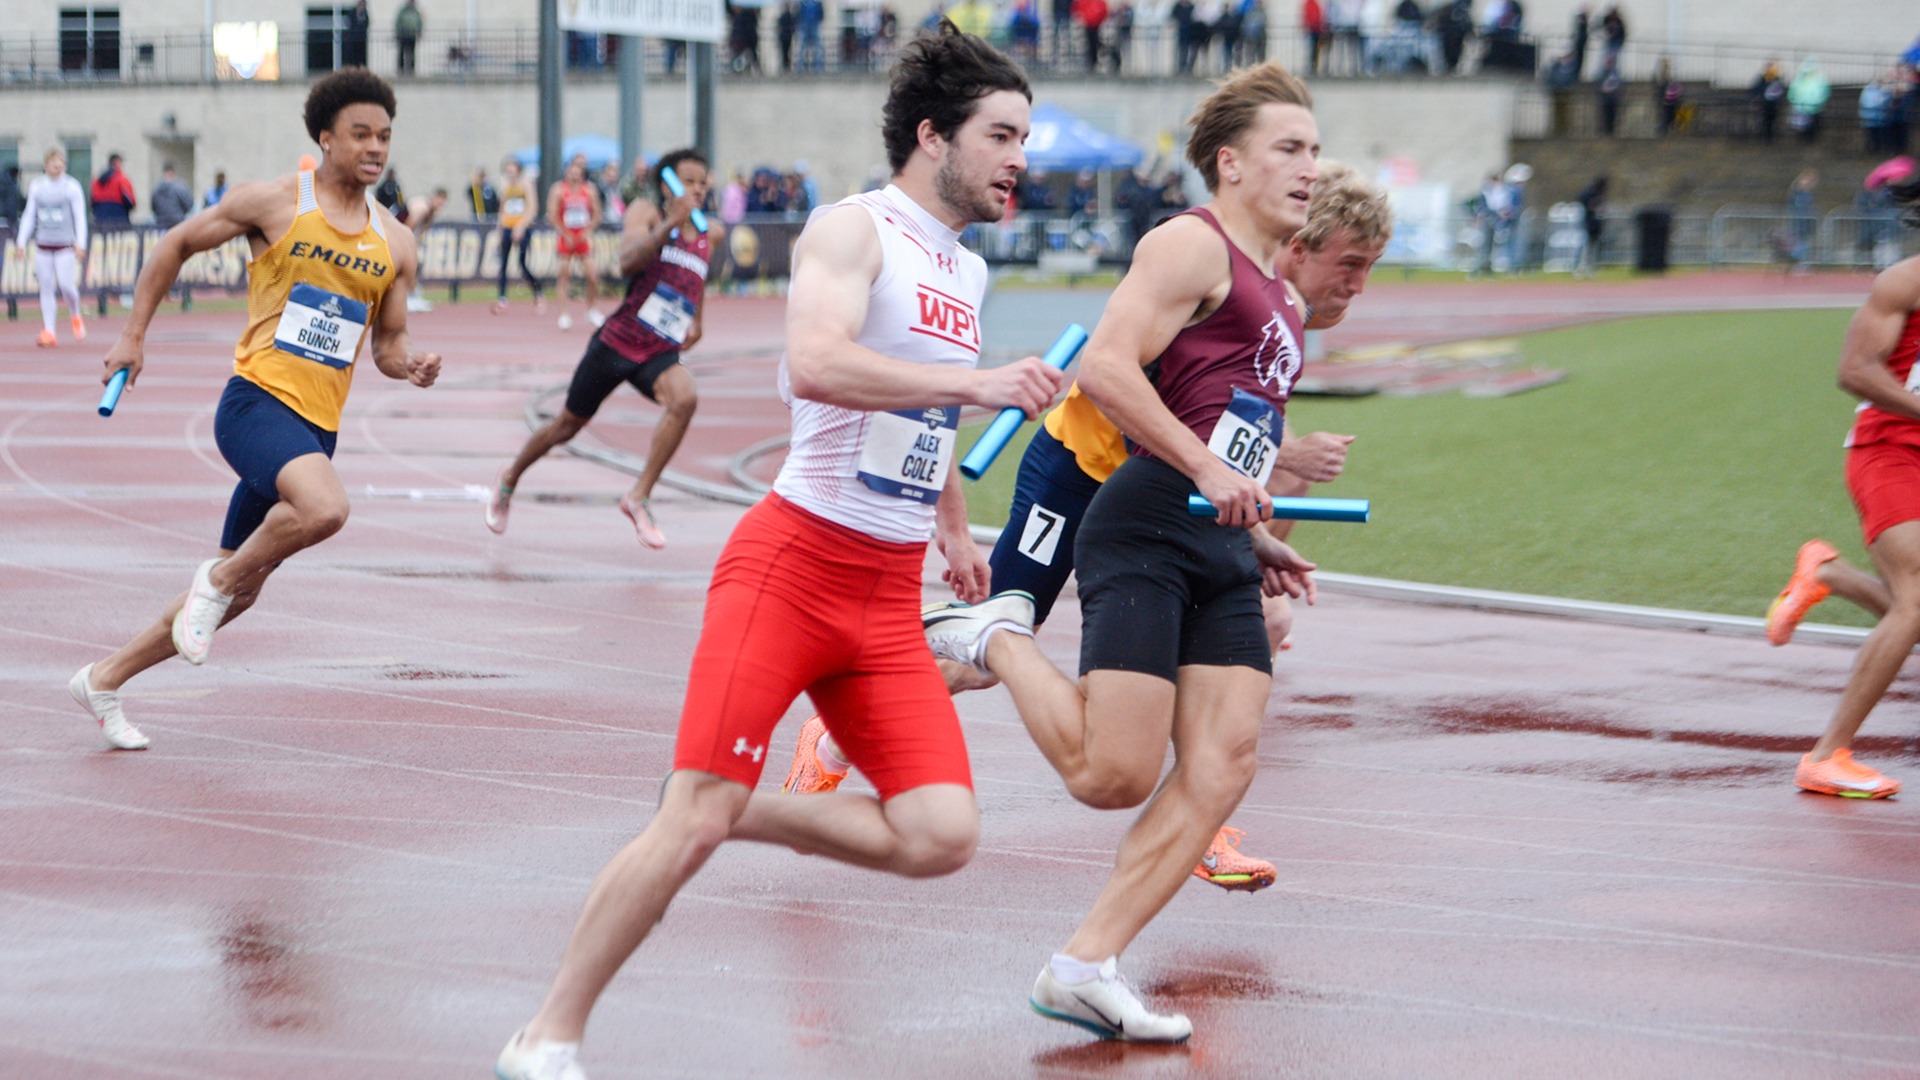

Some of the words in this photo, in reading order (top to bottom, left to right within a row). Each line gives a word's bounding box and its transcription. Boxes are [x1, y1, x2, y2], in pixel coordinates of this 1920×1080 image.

[289, 241, 388, 277] EMORY
[310, 317, 340, 334] CALEB
[917, 292, 980, 346] WPI
[297, 328, 341, 354] BUNCH
[913, 432, 942, 455] ALEX
[1227, 427, 1270, 479] 665
[901, 454, 938, 483] COLE
[1028, 511, 1057, 555] 7
